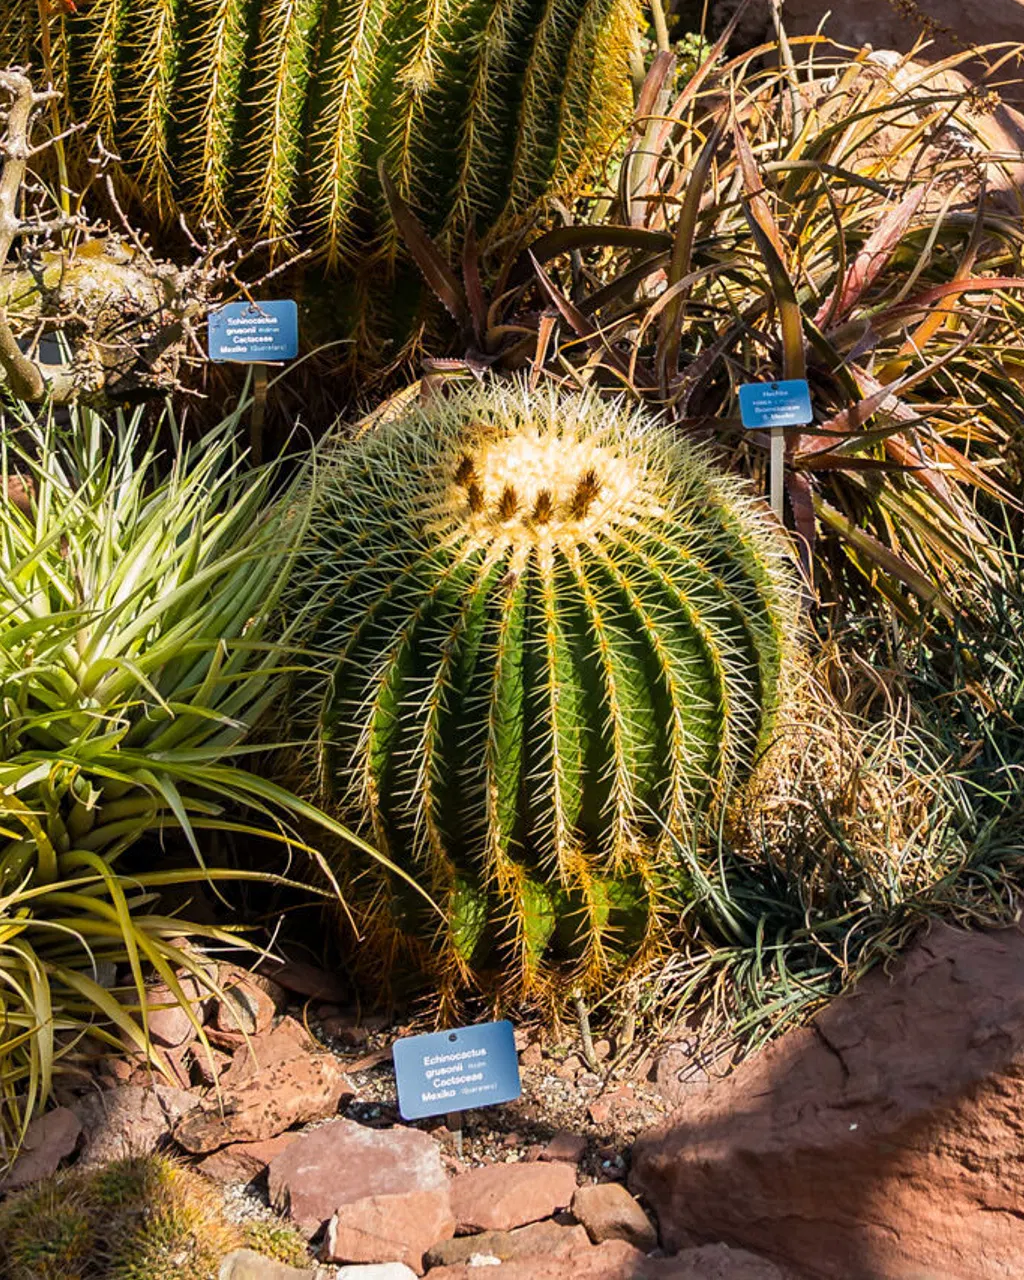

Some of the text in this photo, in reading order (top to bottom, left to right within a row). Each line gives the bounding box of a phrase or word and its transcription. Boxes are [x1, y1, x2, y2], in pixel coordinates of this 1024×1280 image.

[232, 335, 274, 344] Cactaceae
[423, 1047, 487, 1066] Echinocactus
[425, 1062, 463, 1079] grusonii
[432, 1072, 484, 1088] Cactaceae
[421, 1088, 456, 1102] Mexiko
